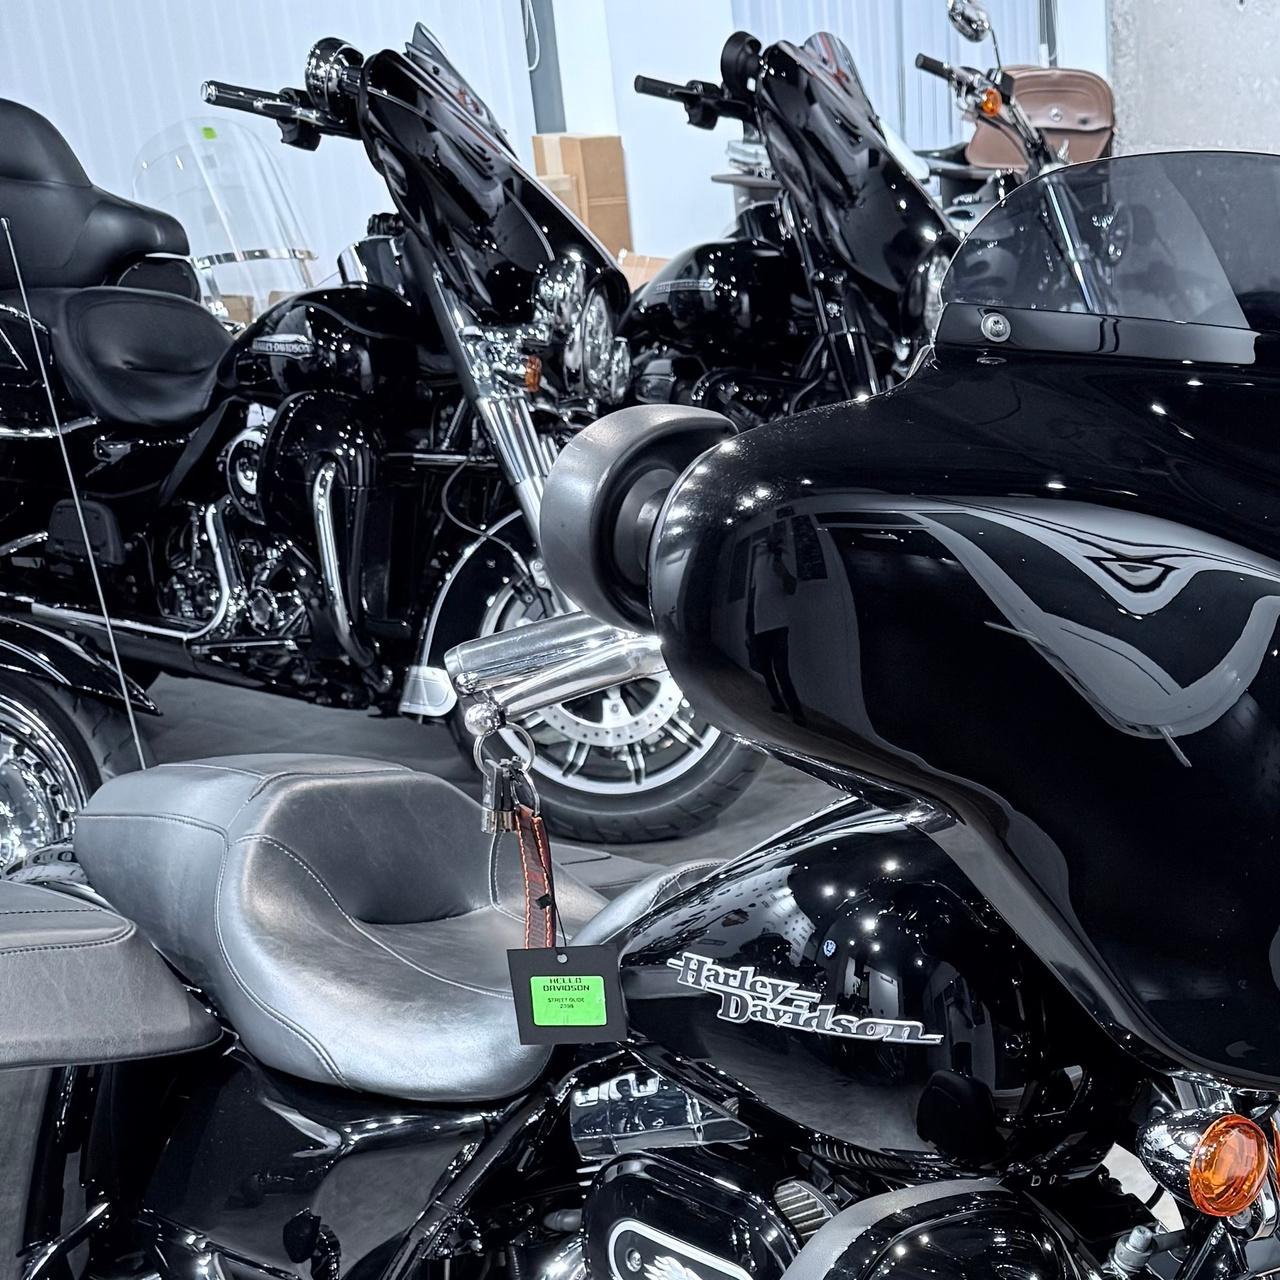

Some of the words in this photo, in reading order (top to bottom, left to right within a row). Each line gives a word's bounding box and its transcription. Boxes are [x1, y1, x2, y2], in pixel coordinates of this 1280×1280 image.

[542, 984, 590, 992] DAVIDSON
[667, 952, 822, 1005] Harley
[716, 991, 945, 1045] Davidson
